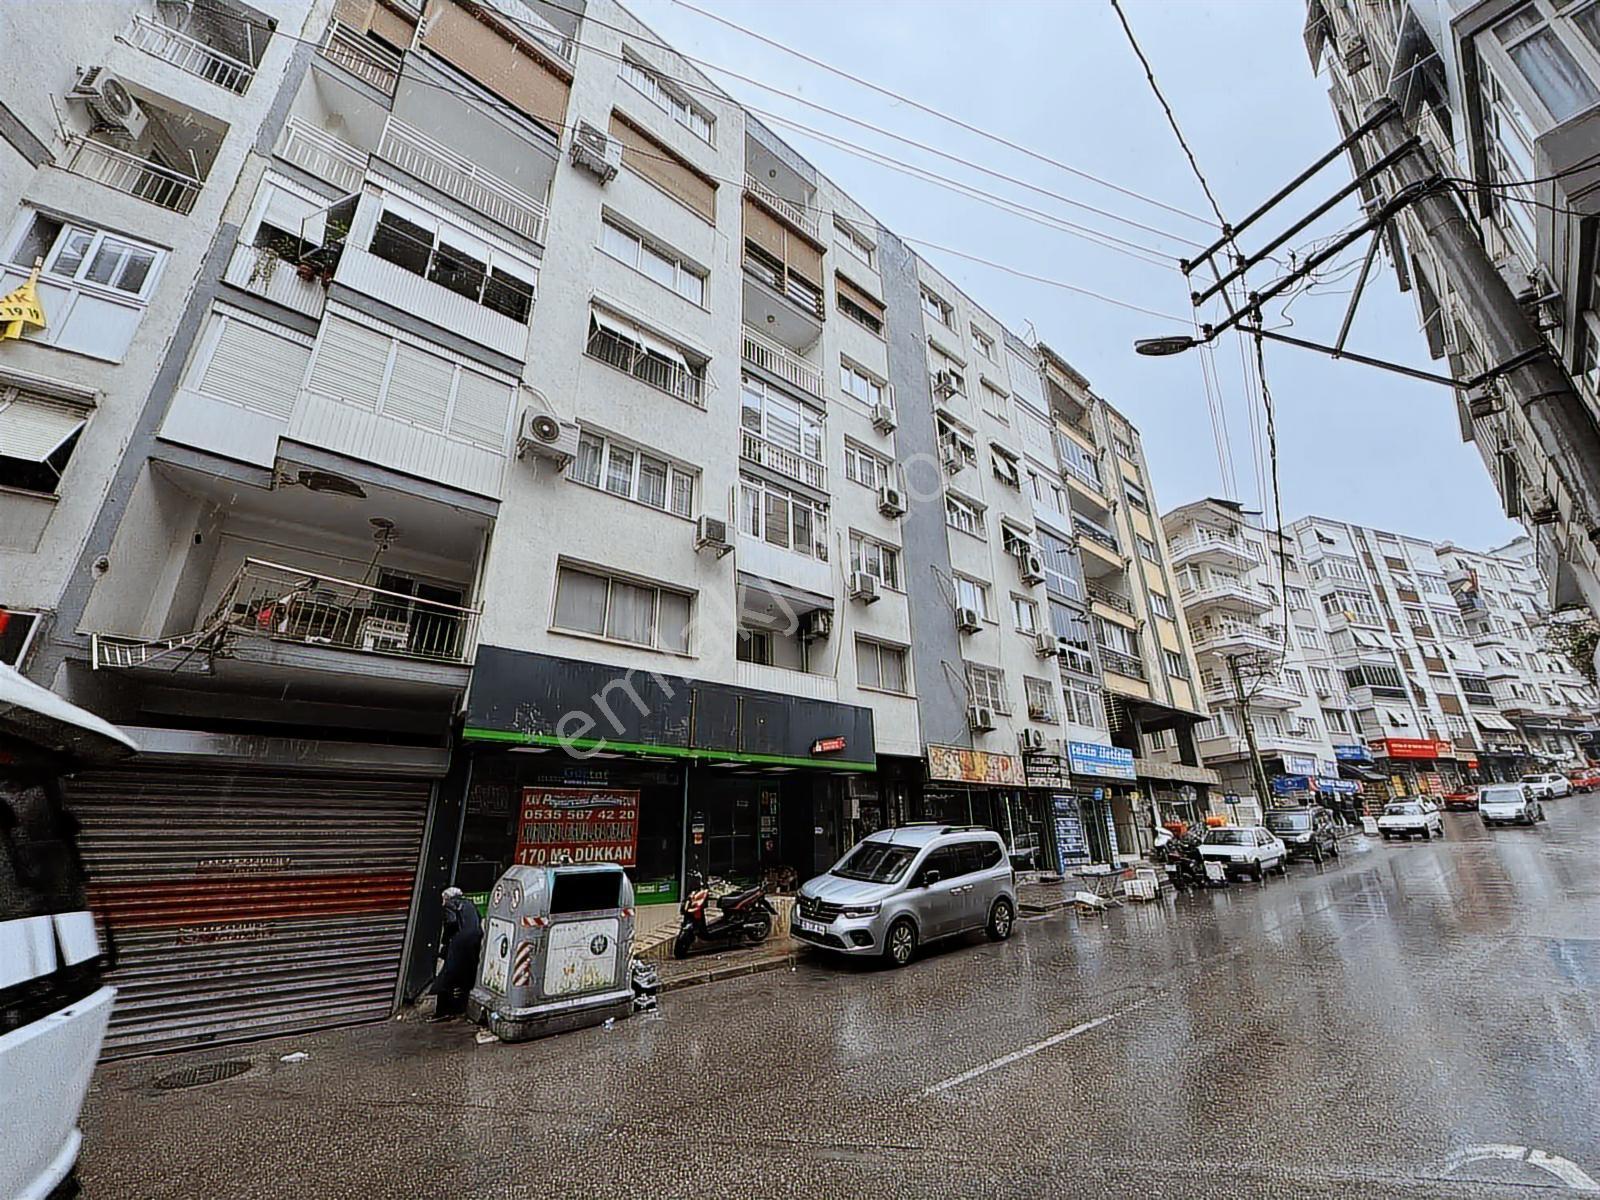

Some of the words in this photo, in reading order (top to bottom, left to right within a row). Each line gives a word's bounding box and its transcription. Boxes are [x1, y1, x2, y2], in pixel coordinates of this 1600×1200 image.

[524, 809, 562, 820] 0535
[597, 810, 615, 820] 42
[619, 810, 635, 820] 20
[520, 848, 547, 865] 170
[574, 844, 633, 862] DÜKKAN
